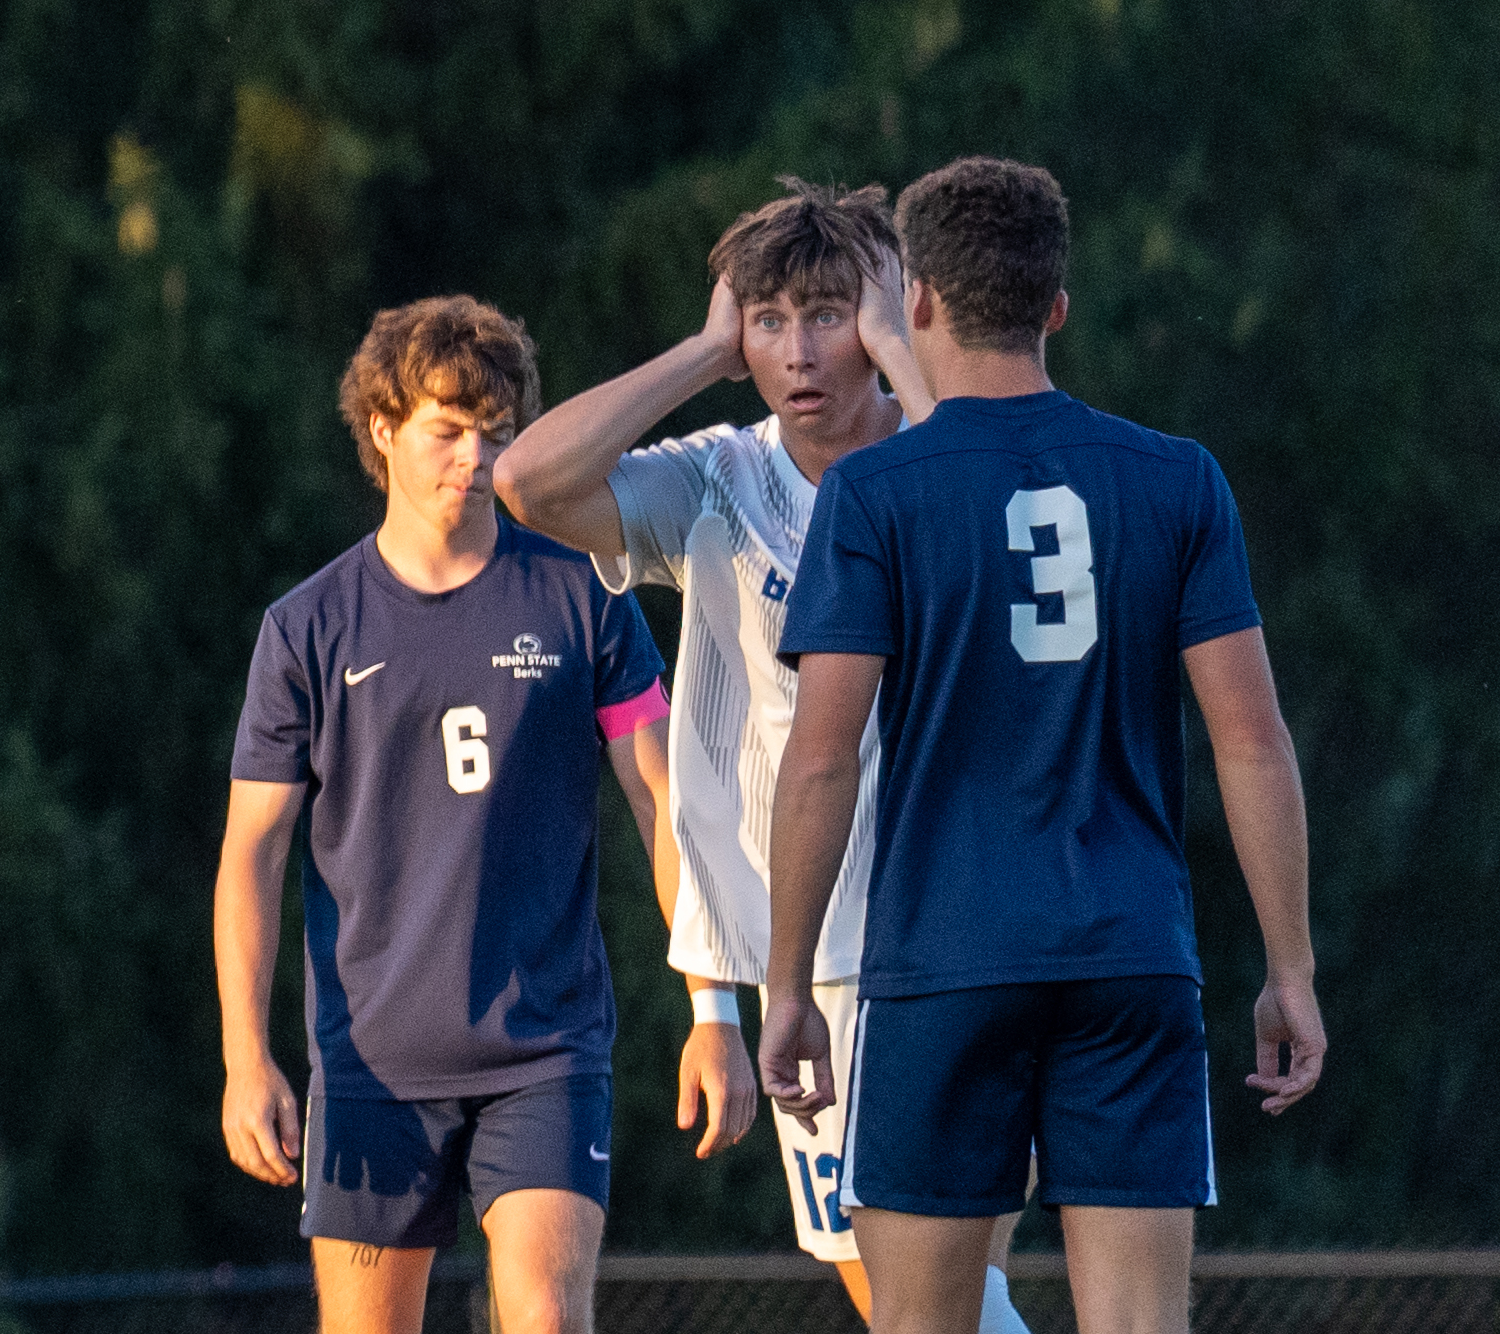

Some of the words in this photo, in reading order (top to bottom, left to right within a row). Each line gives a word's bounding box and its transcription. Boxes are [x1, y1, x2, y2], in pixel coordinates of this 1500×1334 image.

[1006, 484, 1098, 663] 3
[492, 654, 525, 668] PENN
[527, 654, 561, 667] STATE
[442, 705, 491, 794] 6
[792, 1147, 853, 1234] 12
